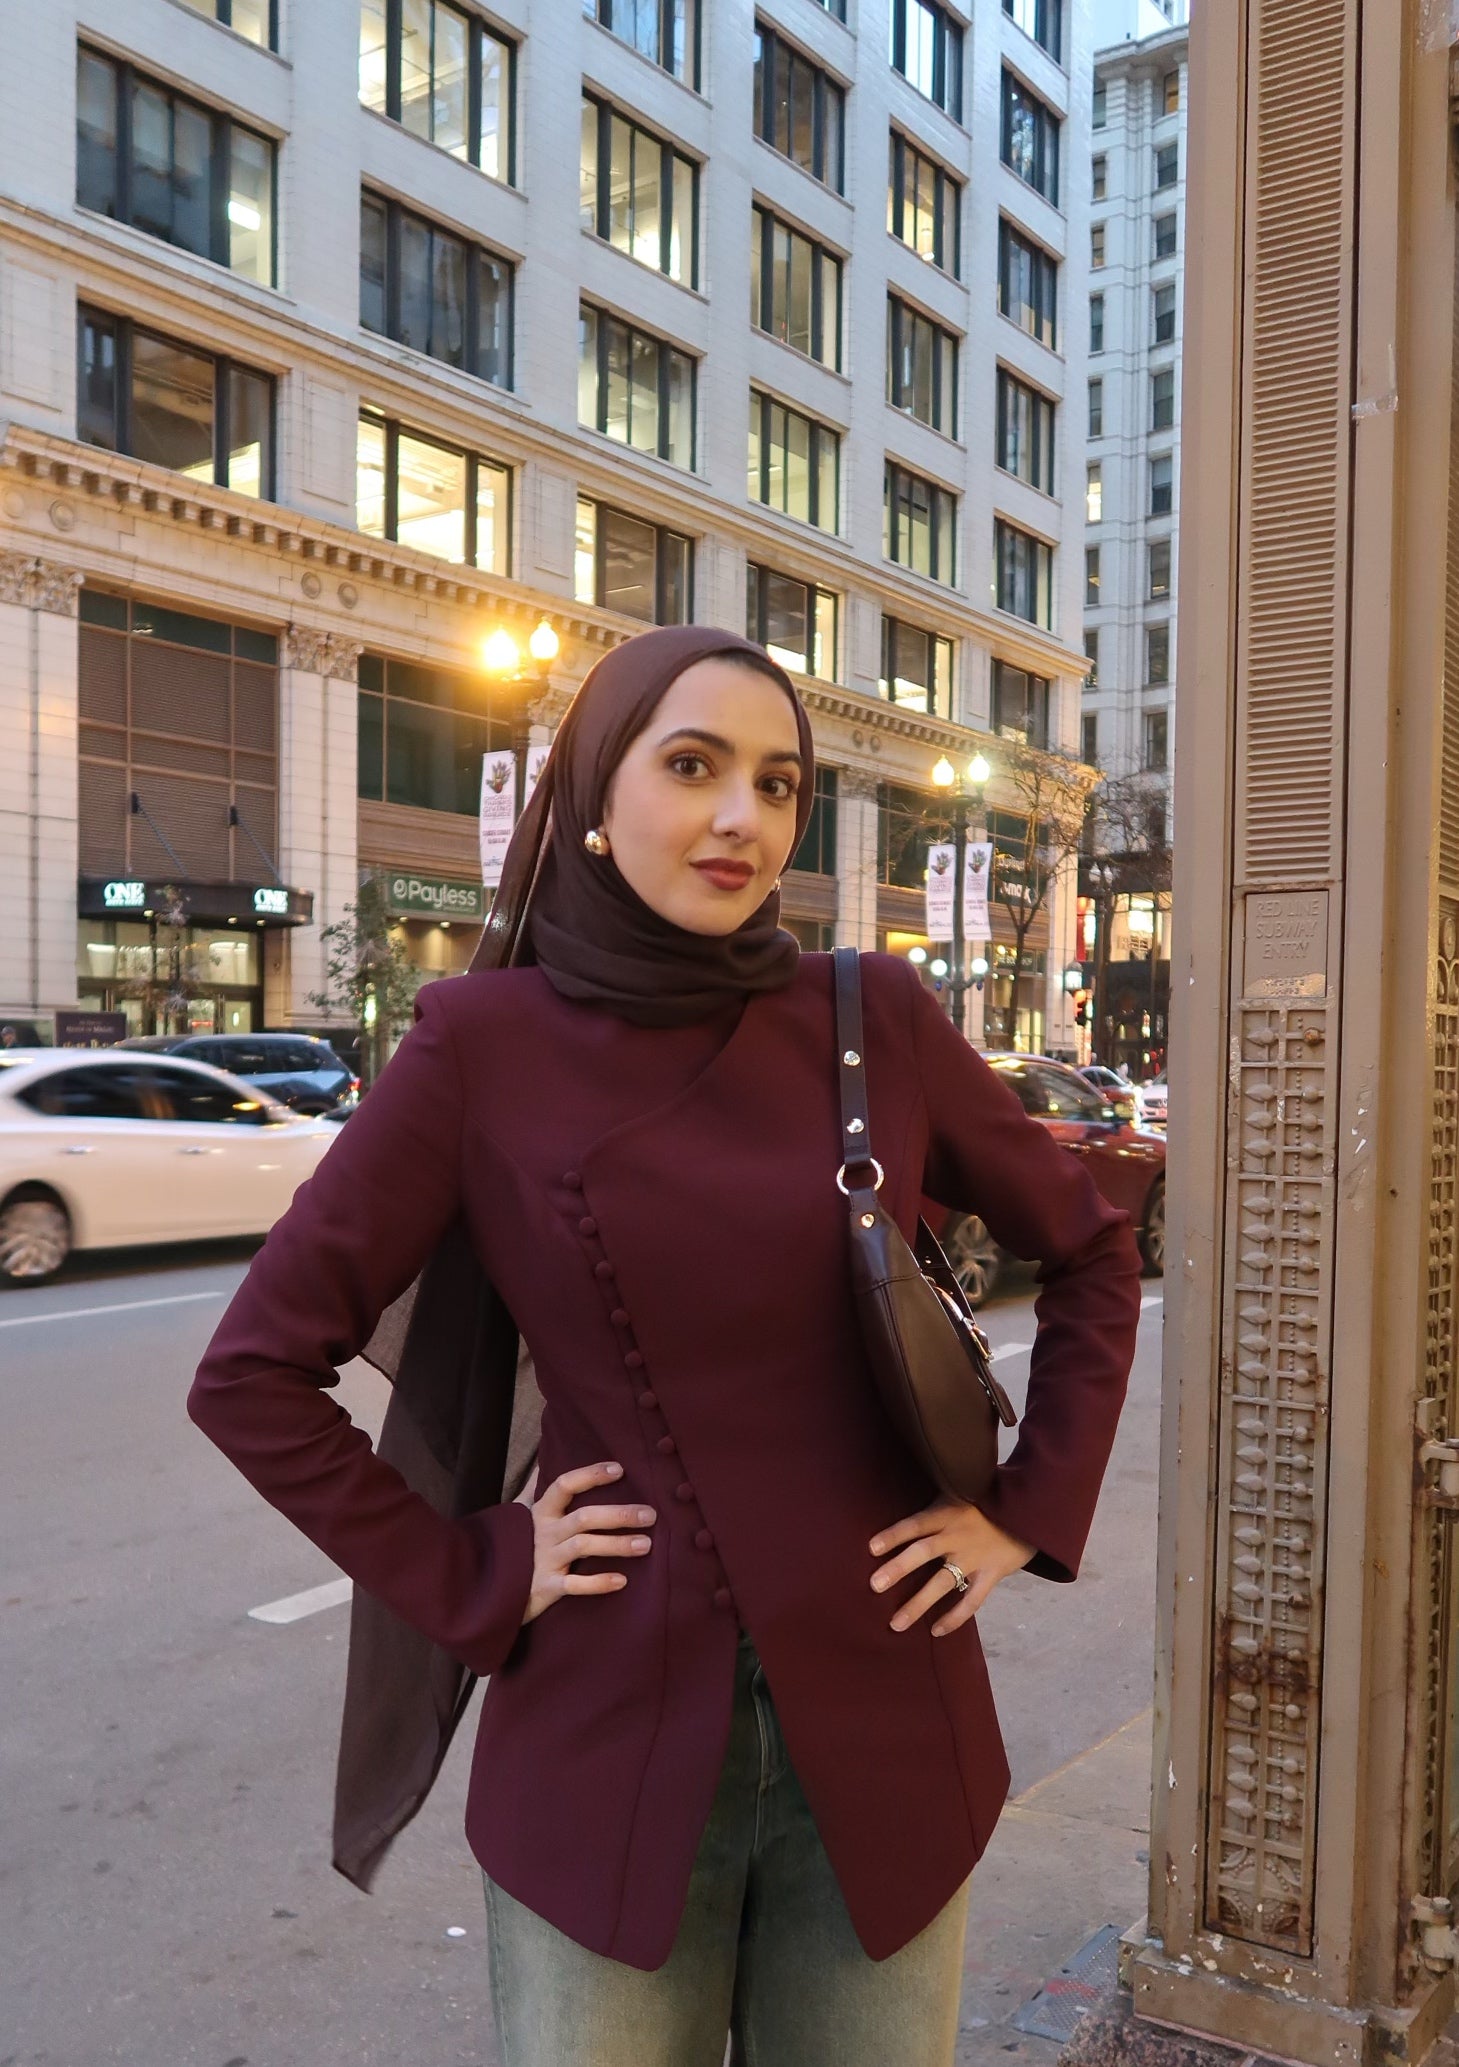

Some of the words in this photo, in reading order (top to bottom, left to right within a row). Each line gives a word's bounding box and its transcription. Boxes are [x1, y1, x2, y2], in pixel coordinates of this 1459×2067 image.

[104, 882, 145, 900] ONE
[408, 880, 477, 908] Payless
[1256, 899, 1283, 918] RED
[1287, 897, 1321, 917] LINE
[1256, 919, 1318, 939] SUBWAY
[1262, 941, 1310, 960] ENTRY
